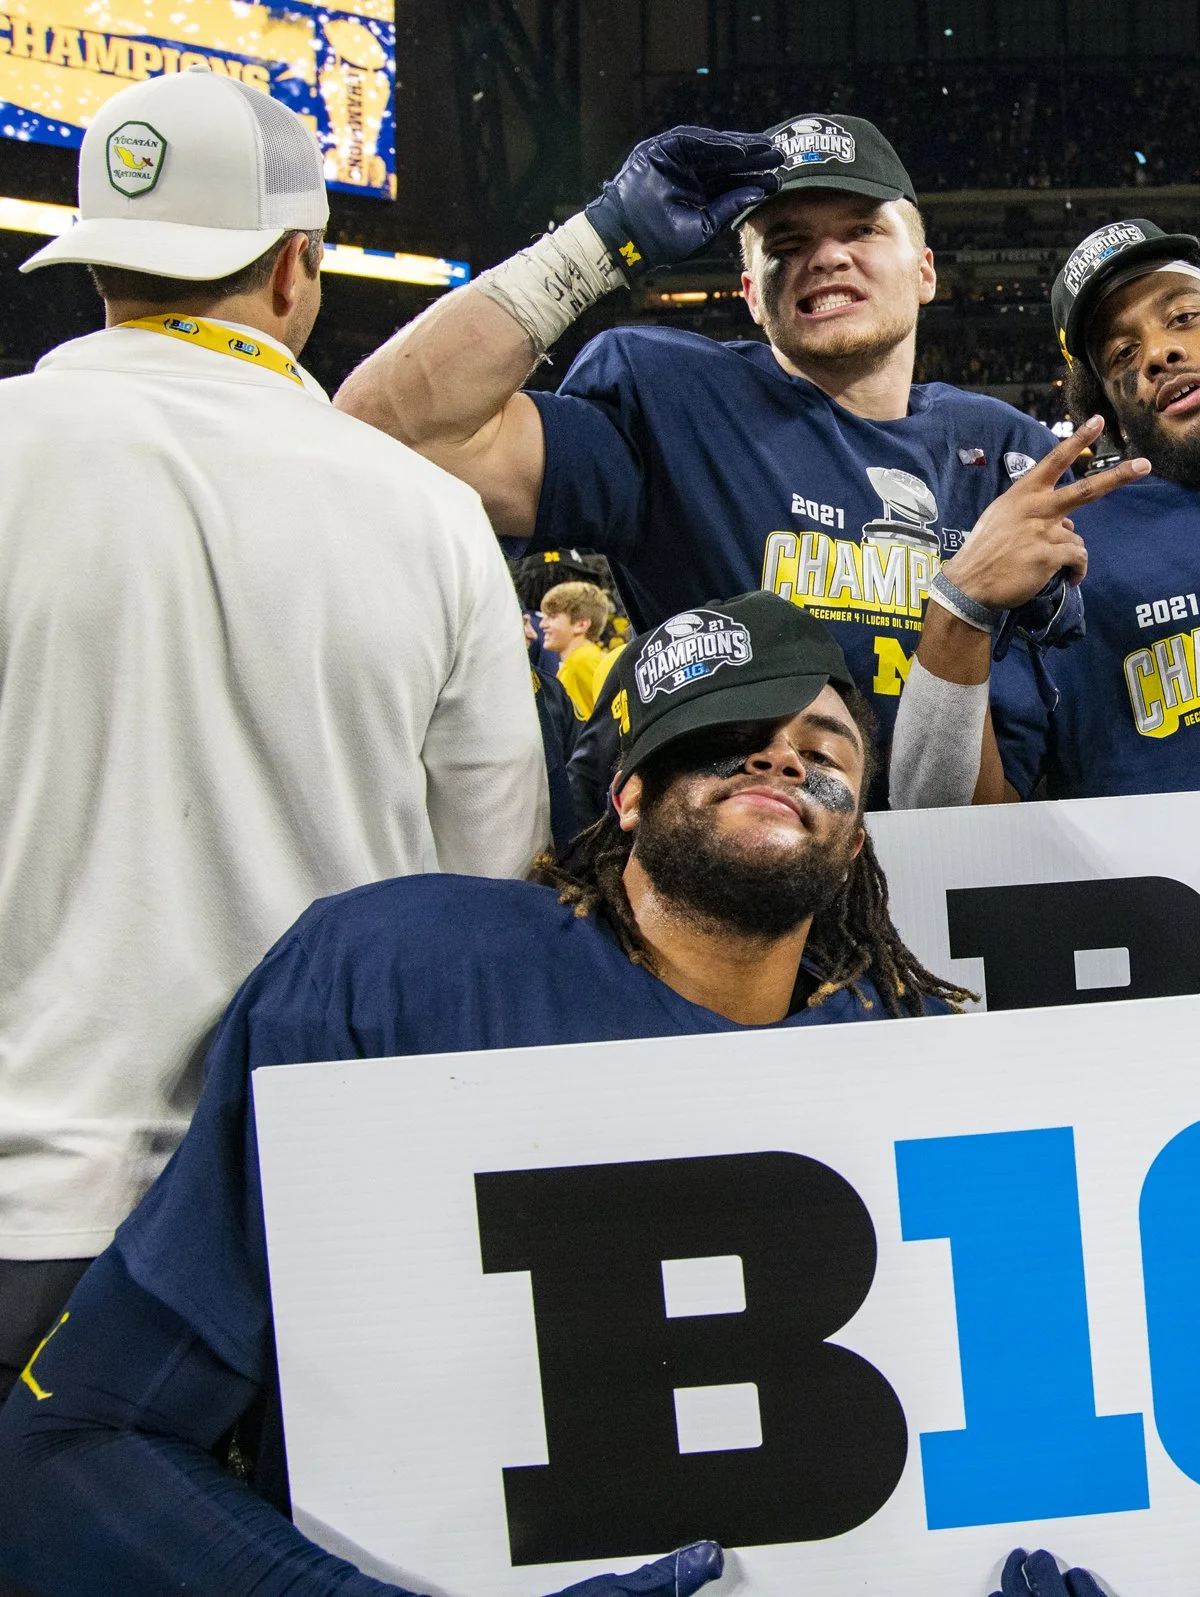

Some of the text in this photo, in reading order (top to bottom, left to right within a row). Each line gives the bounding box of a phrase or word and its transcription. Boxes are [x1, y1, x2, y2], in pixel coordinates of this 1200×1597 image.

[825, 126, 838, 135] 21
[773, 134, 853, 159] AMPIONS
[113, 169, 152, 180] NATIONAL
[618, 241, 642, 267] M
[1066, 227, 1143, 295] CHAMPIONS
[792, 493, 845, 530] 2021
[809, 608, 852, 622] DECEMBER
[854, 613, 860, 622] 4
[866, 615, 890, 627] LUCAS
[892, 619, 903, 629] OIL
[1136, 593, 1200, 629] 2021
[708, 619, 725, 632] 21
[648, 641, 663, 658] 20
[637, 630, 747, 698] CHAMPIONS
